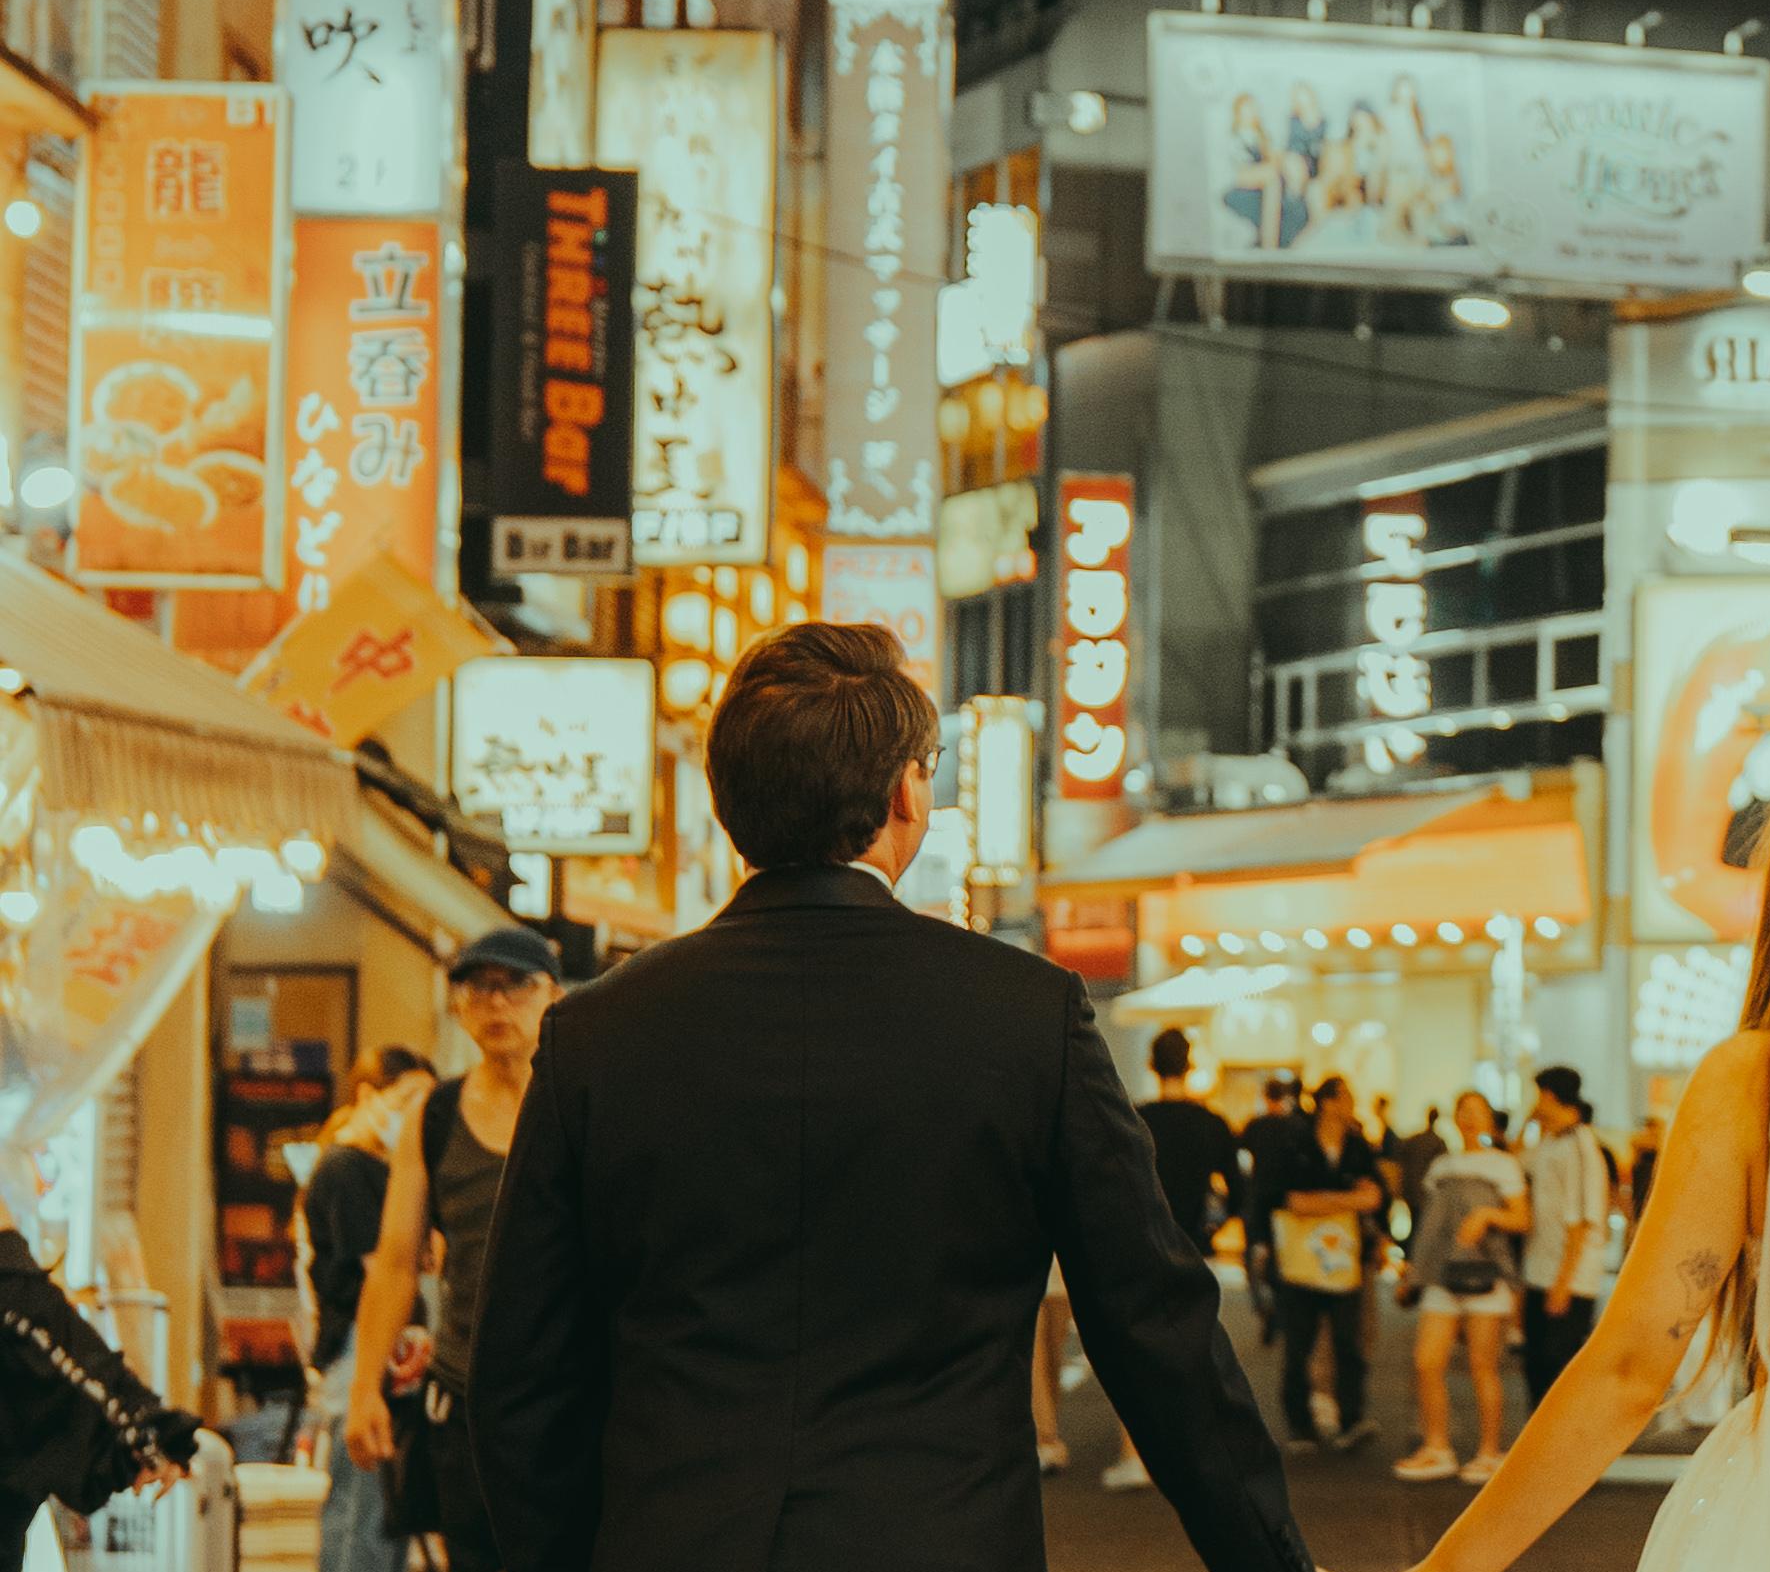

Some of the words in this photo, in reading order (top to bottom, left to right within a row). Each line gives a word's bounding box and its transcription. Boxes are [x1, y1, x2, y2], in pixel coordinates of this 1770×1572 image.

[348, 241, 429, 486] 立呑み
[544, 187, 608, 373] THREE
[542, 376, 606, 497] Bar
